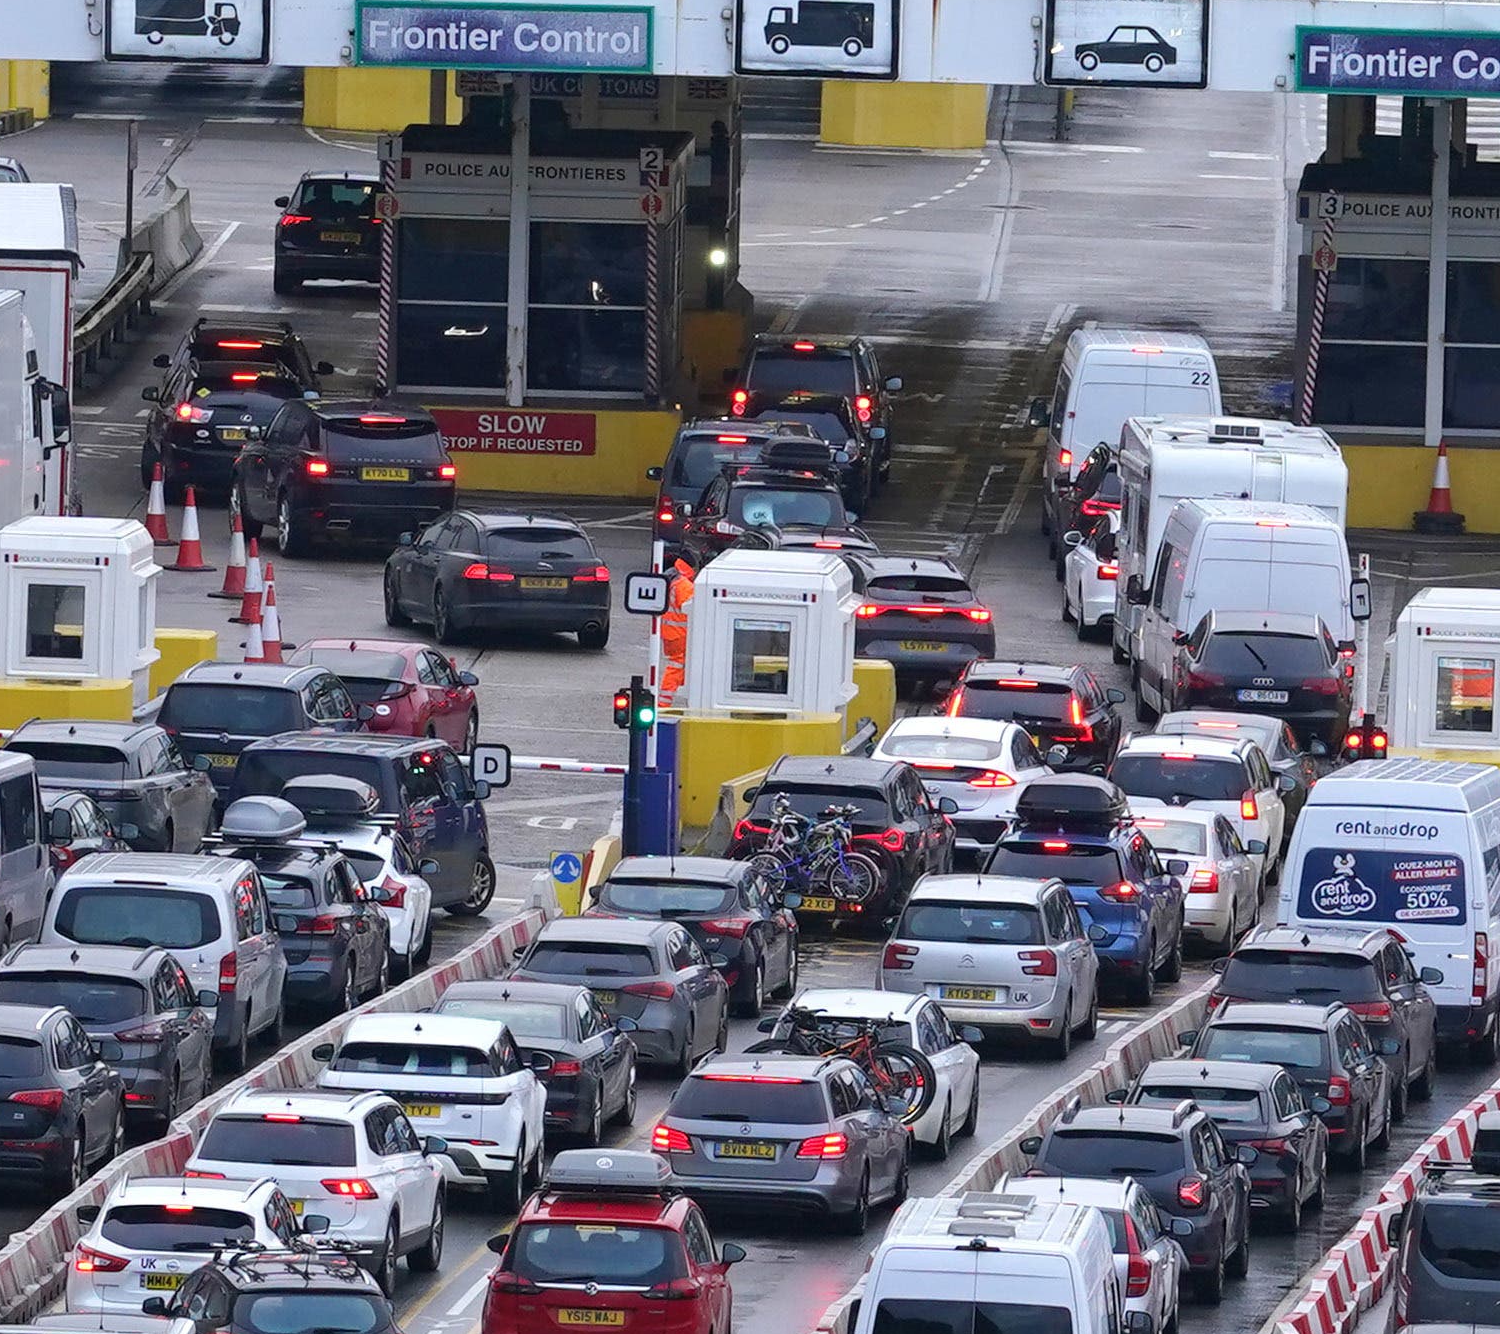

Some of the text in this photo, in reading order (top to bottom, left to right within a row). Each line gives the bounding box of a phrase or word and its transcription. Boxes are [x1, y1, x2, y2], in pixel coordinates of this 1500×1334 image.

[369, 20, 641, 55] Frontier Control
[1308, 45, 1443, 78] Frontier
[643, 151, 658, 169] 2
[1325, 197, 1338, 216] 3
[1191, 371, 1211, 386] 22
[476, 414, 546, 434] SLOW
[442, 436, 583, 452] STOP IF REQUESTED
[1355, 594, 1366, 606] F
[483, 756, 498, 775] D
[1336, 820, 1439, 840] rent and drop
[1395, 869, 1457, 880] ALLER SIMPLE
[1320, 880, 1350, 897] rent
[1320, 893, 1370, 909] and drop
[1407, 891, 1448, 909] 50%
[1014, 991, 1029, 1003] UK
[140, 1258, 157, 1269] UK
